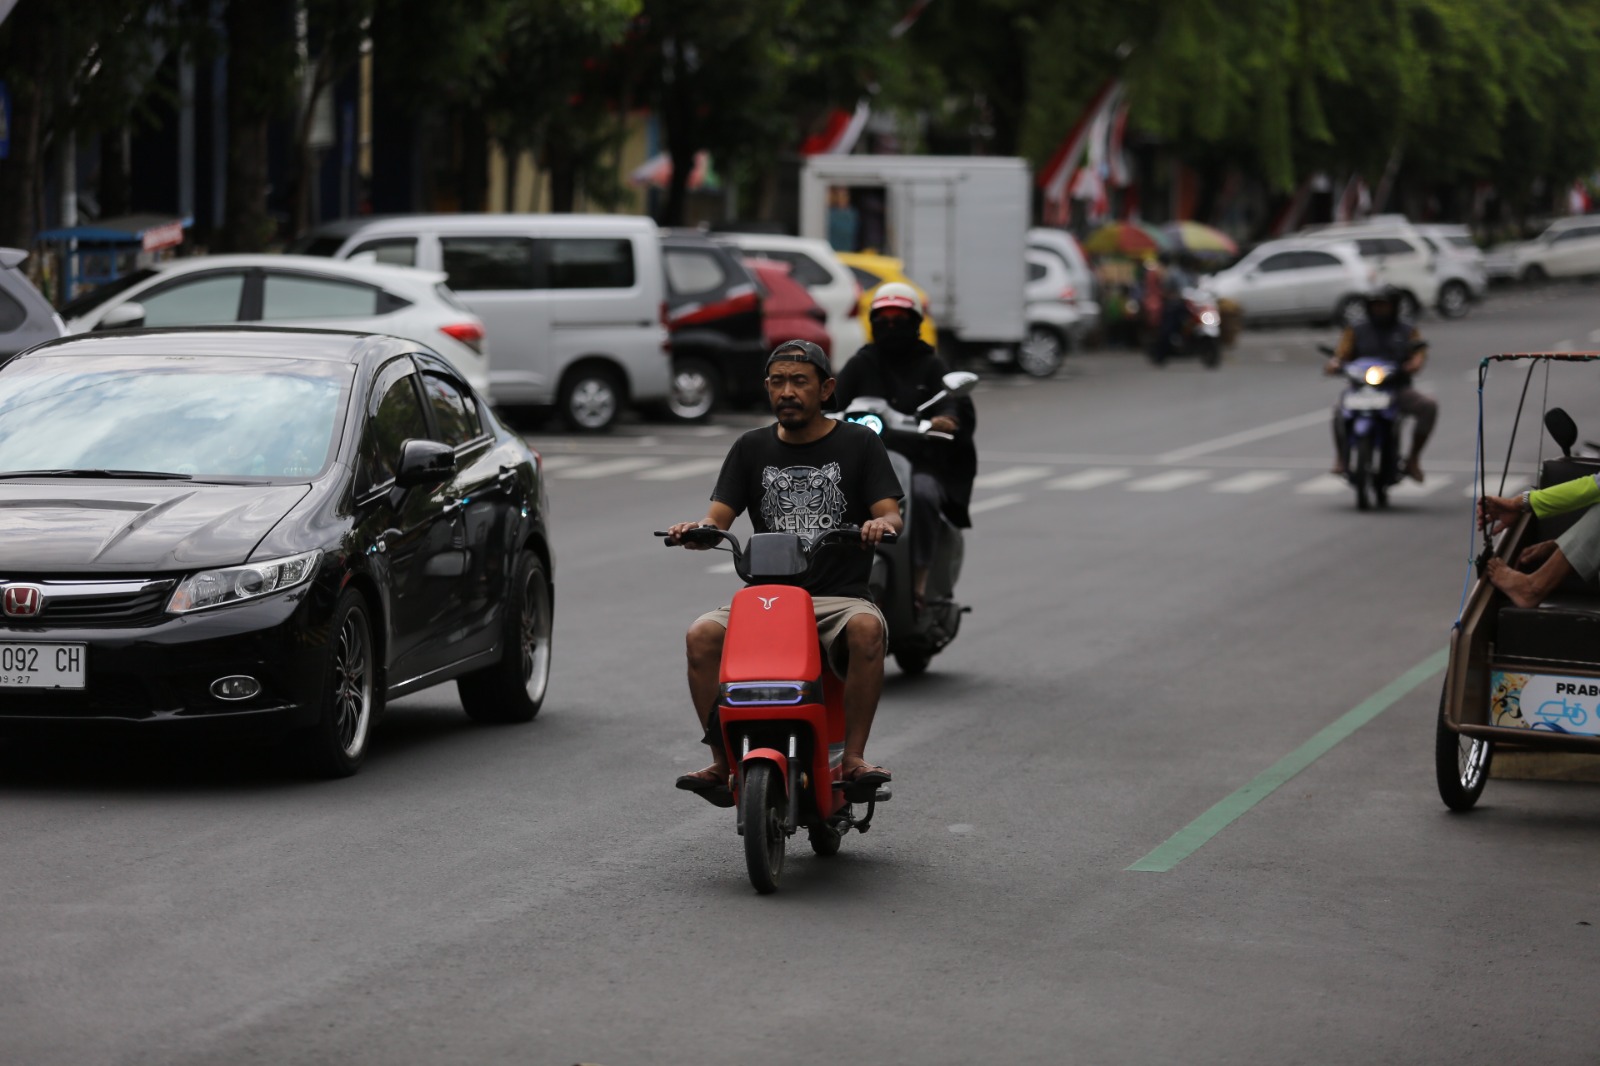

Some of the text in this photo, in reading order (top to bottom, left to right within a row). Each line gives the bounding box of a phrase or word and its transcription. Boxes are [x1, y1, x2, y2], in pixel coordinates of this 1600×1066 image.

[774, 513, 833, 530] KENZO
[56, 647, 80, 672] CH
[1556, 682, 1600, 697] PRAB
